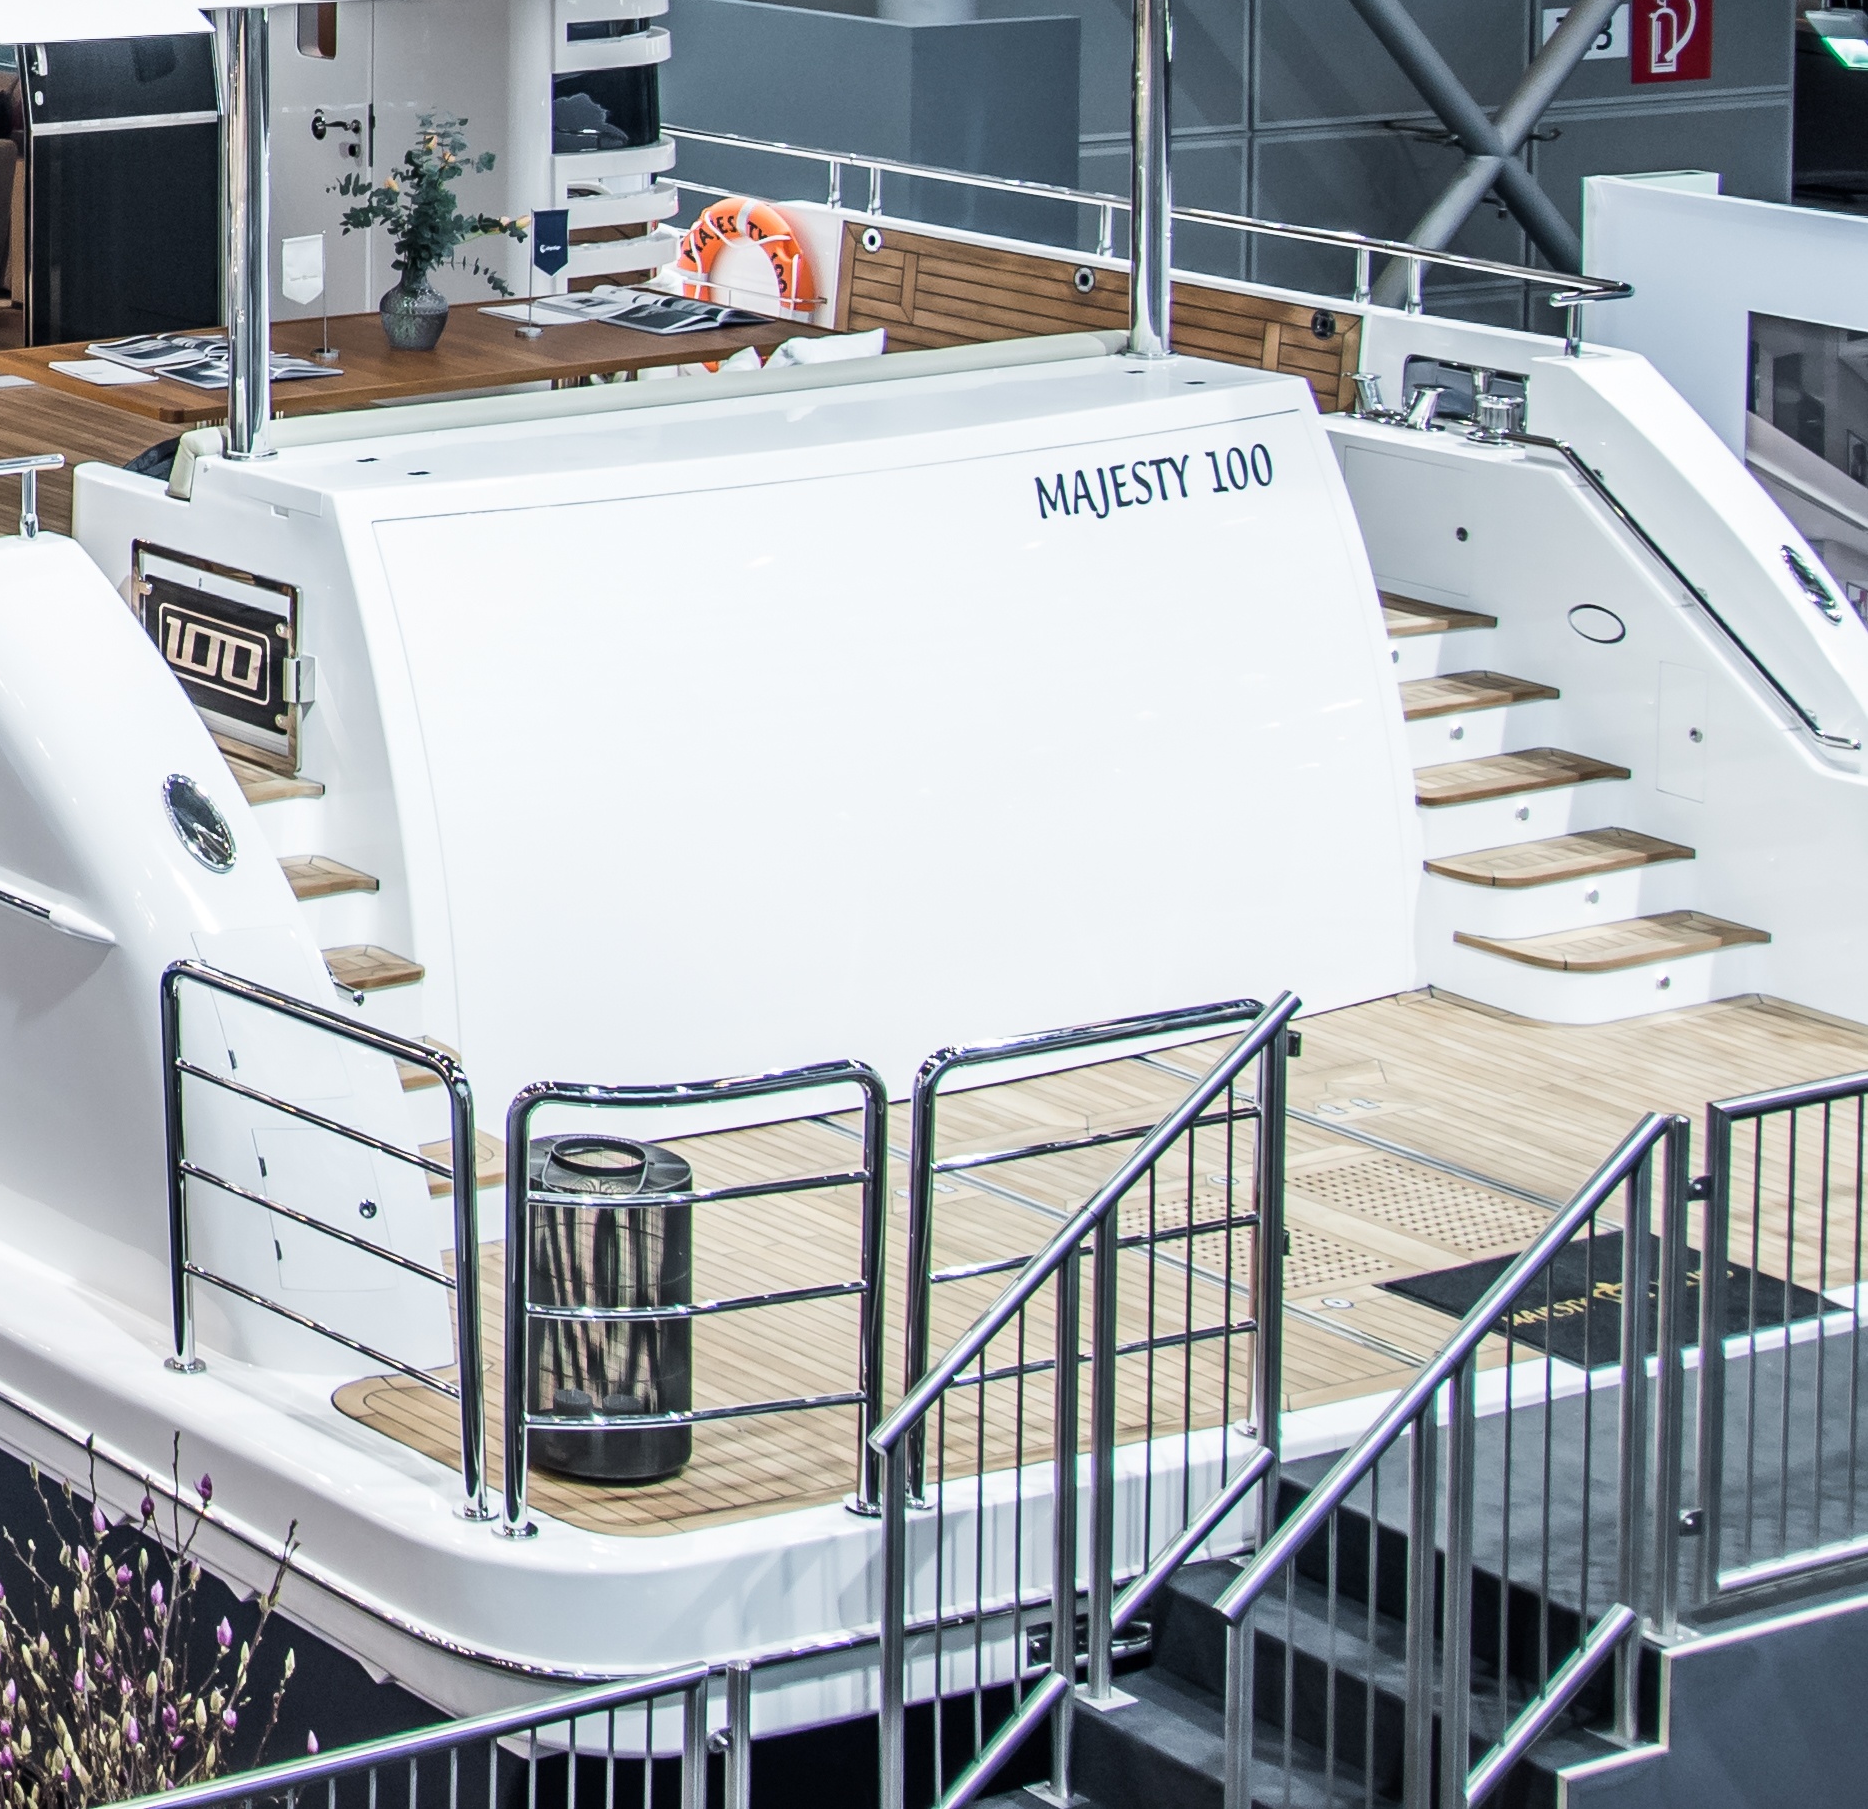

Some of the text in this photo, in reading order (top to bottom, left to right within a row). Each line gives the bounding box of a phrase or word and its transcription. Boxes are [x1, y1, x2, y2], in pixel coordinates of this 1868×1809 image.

[1034, 443, 1273, 520] MAJESTY 100
[166, 615, 263, 691] 100
